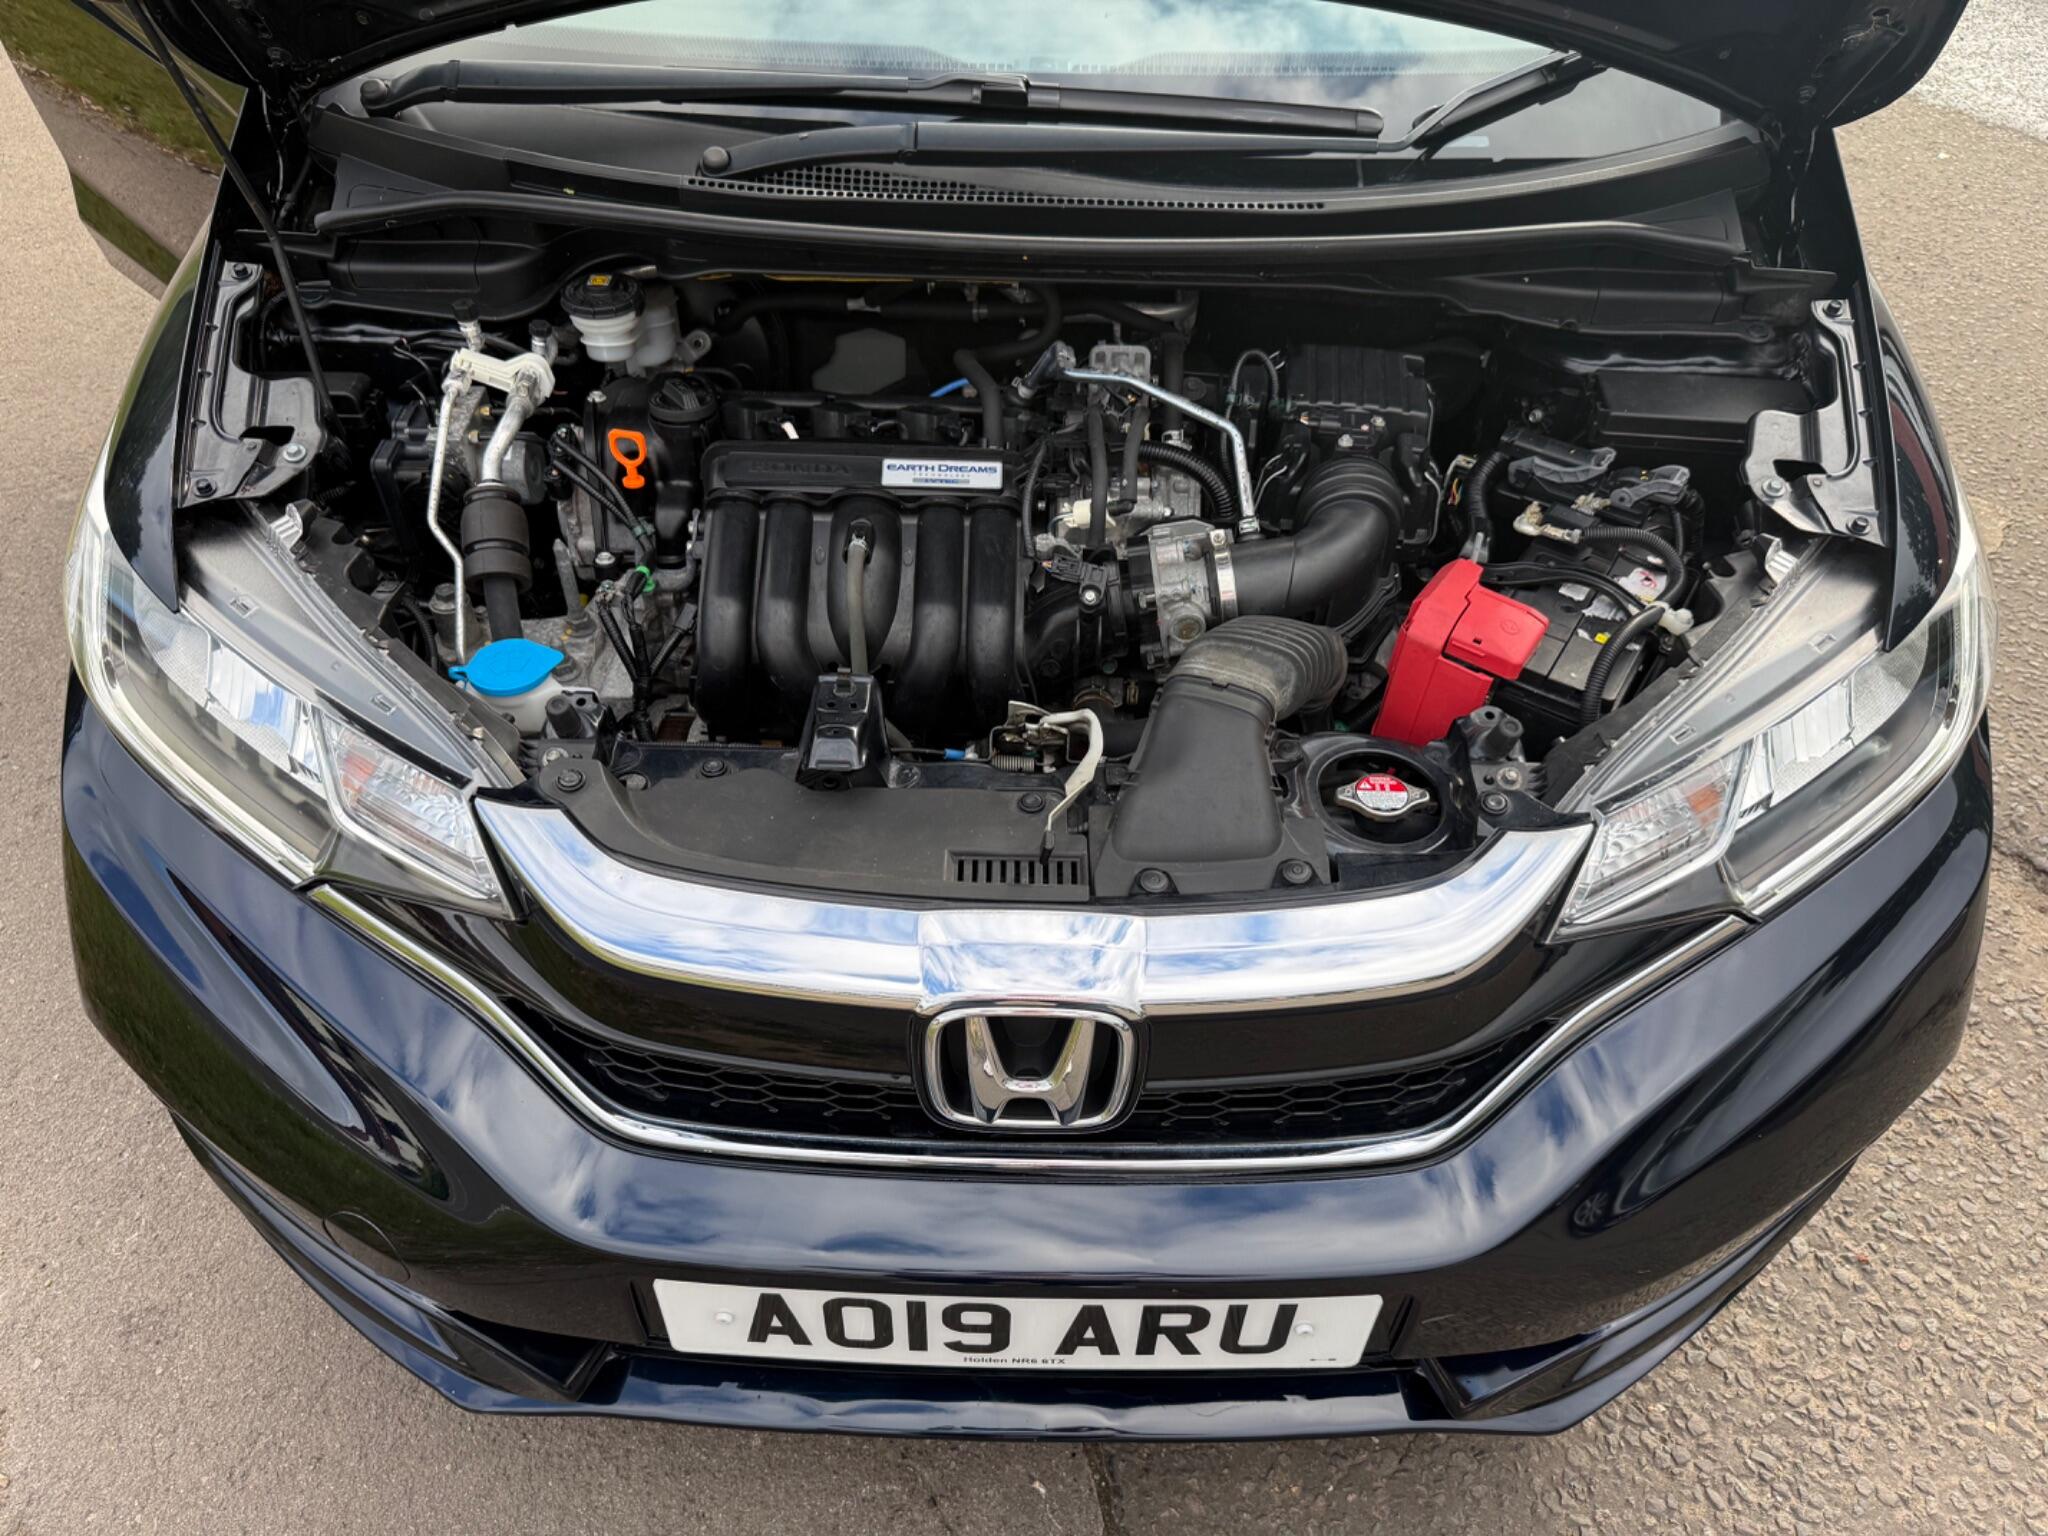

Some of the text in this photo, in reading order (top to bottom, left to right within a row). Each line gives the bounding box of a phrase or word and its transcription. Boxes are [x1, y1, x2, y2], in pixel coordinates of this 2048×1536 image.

[887, 463, 998, 473] EARTH DREAMS
[747, 1292, 1299, 1356] AO19 ARU
